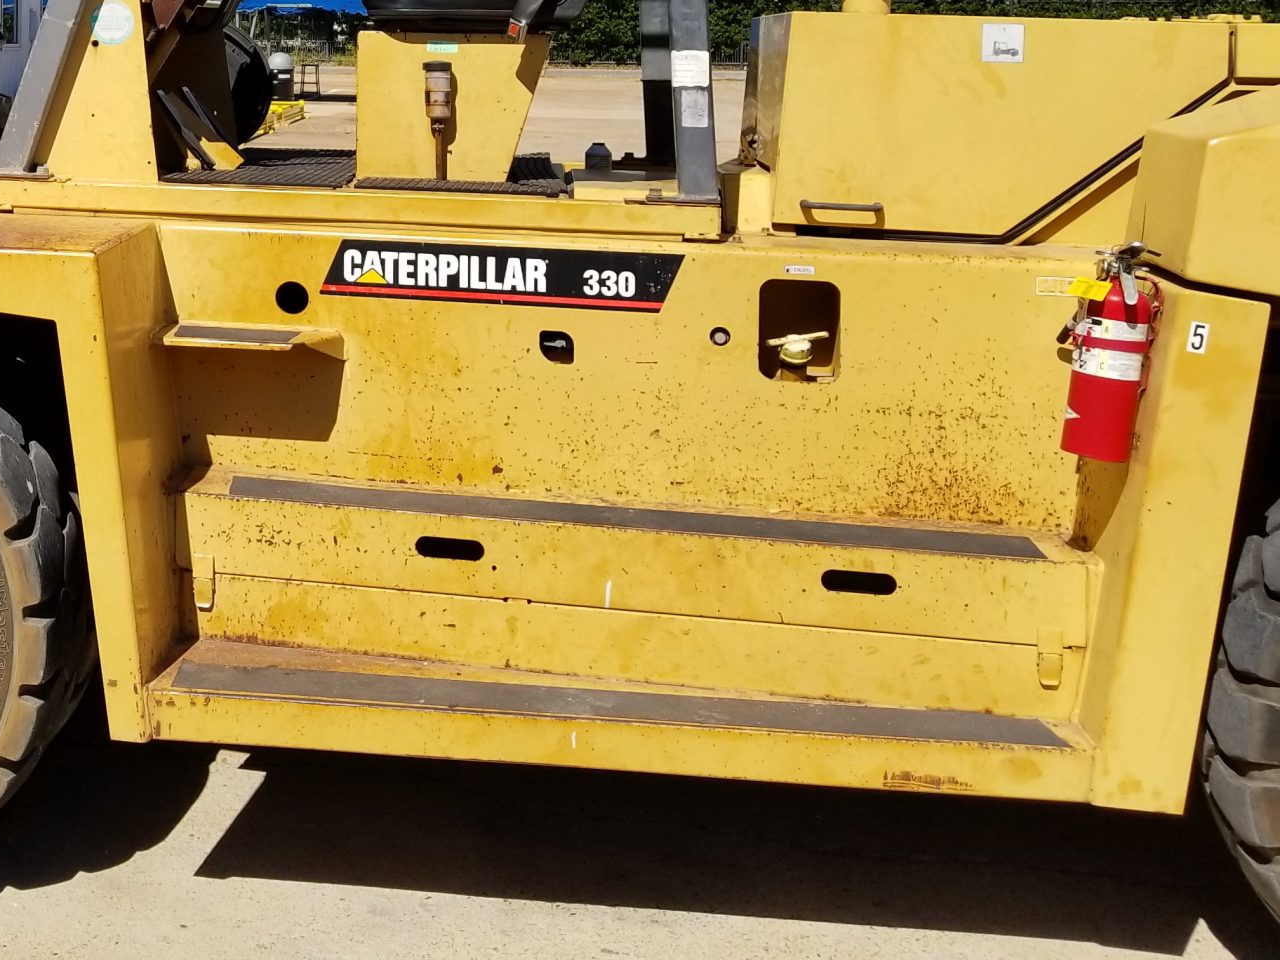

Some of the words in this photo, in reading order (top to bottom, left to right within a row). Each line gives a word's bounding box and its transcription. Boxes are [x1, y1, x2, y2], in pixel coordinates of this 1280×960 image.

[343, 248, 548, 293] CATERPILLAR
[582, 269, 636, 298] 330
[1191, 324, 1206, 351] 5
